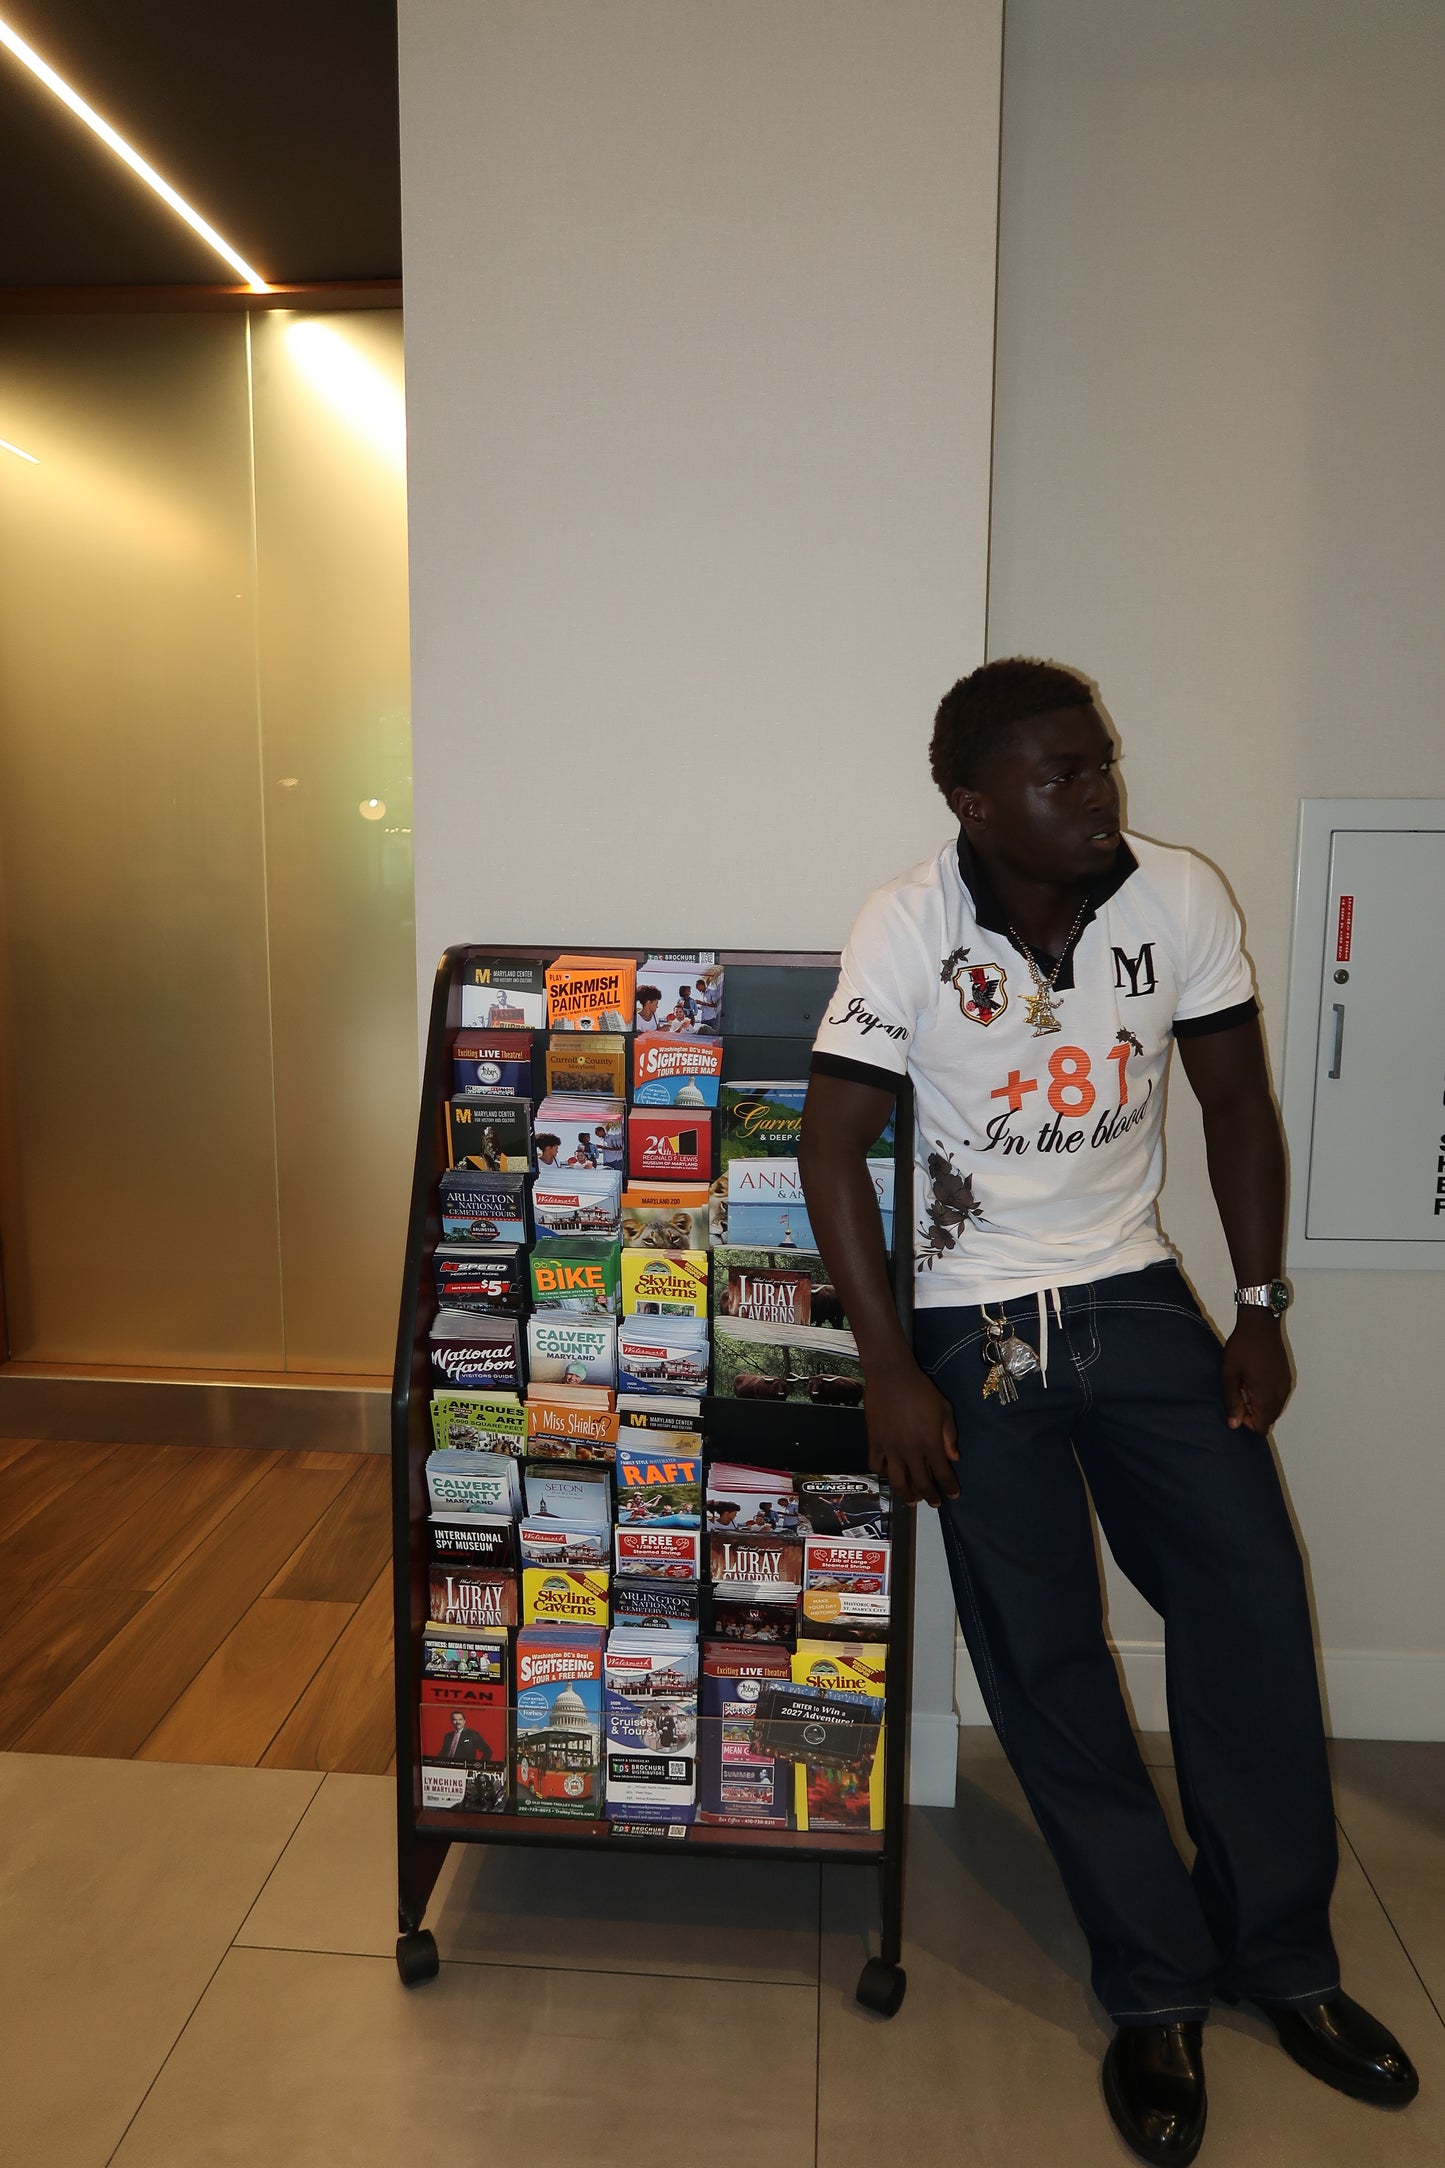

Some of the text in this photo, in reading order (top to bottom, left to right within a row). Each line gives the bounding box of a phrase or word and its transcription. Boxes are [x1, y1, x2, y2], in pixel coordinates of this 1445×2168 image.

[493, 969, 533, 978] MARYLAND CENTER
[549, 974, 562, 982] PLAY
[549, 975, 619, 998] SKIRMISH
[551, 990, 621, 1014] PAINTBALL
[828, 997, 909, 1041] Japan
[457, 1049, 523, 1060] Exciting LIVE Theatre!
[550, 1056, 614, 1066] Carroll County
[646, 1047, 718, 1074] SIGHTSEEING
[657, 1067, 674, 1077] TOUR
[682, 1066, 699, 1074] FREE
[700, 1067, 716, 1075] MAP
[990, 1043, 1131, 1118] +81
[473, 1110, 516, 1118] MARYLAND CENTER
[733, 1101, 802, 1138] Garret
[966, 1078, 1153, 1156] In the blood
[760, 1133, 766, 1141] &
[446, 1192, 515, 1204] ARLINGTON
[777, 1190, 786, 1199] &
[458, 1201, 506, 1211] NATIONAL
[670, 1198, 681, 1206] ZOO
[448, 1208, 517, 1218] CEMETERY TOURS
[458, 1263, 508, 1272] SPEED
[535, 1266, 606, 1291] BIKE
[639, 1274, 697, 1288] Skyline
[481, 1279, 502, 1296] $5
[634, 1284, 698, 1299] Caverns
[738, 1274, 798, 1308] LURAY
[738, 1304, 795, 1324] CAVERNS
[535, 1328, 606, 1344] CALVERT
[535, 1340, 606, 1355] COUNTY
[431, 1345, 513, 1370] National
[546, 1352, 596, 1361] MARYLAND
[446, 1360, 517, 1382] Harbor
[449, 1401, 525, 1417] ANTIQUES
[470, 1420, 502, 1429] SQUARE
[504, 1424, 524, 1432] FEET
[476, 1413, 525, 1426] & ART
[543, 1410, 607, 1440] Miss Shirley's
[649, 1416, 694, 1426] MARYLAND CENTER
[622, 1462, 695, 1486] RAFT
[432, 1477, 501, 1491] CALVERT
[545, 1482, 584, 1493] SETON
[434, 1488, 502, 1500] COUNTY
[446, 1498, 494, 1506] MARYLAND
[434, 1529, 504, 1543] INTERNATIONAL
[640, 1535, 673, 1546] FREE
[436, 1539, 494, 1552] SPY MUSEUM
[722, 1543, 782, 1575] LURAY
[830, 1549, 864, 1560] FREE
[445, 1576, 504, 1611] LURAY
[537, 1590, 596, 1606] Skyline
[619, 1591, 690, 1607] ARLINGTON
[533, 1600, 597, 1616] Caverns
[620, 1605, 690, 1618] CEMETERY TOURS
[631, 1600, 680, 1612] NATIONAL
[445, 1608, 502, 1626] CAVERNS
[531, 1652, 563, 1660] Washington
[607, 1657, 649, 1667] Watermark
[520, 1656, 595, 1682] SIGHTSEEING
[716, 1666, 788, 1678] Exciting LIVE Theatre!
[532, 1674, 550, 1685] TOUR
[558, 1672, 576, 1680] FREE
[577, 1671, 593, 1679] MAP
[805, 1675, 867, 1690] Skyline
[431, 1687, 493, 1701] TITAN
[792, 1701, 812, 1711] ENTER
[822, 1706, 841, 1717] Win
[610, 1716, 653, 1727] Cruises
[781, 1707, 855, 1728] 2027 Adventure!
[611, 1726, 653, 1736] & Tours
[723, 1746, 743, 1755] MEAN
[612, 1762, 630, 1773] TDS
[723, 1770, 756, 1779] SUMMER
[423, 1776, 463, 1788] LYNCHING
[431, 1785, 464, 1794] MARYLAND
[611, 1824, 630, 1833] TDS
